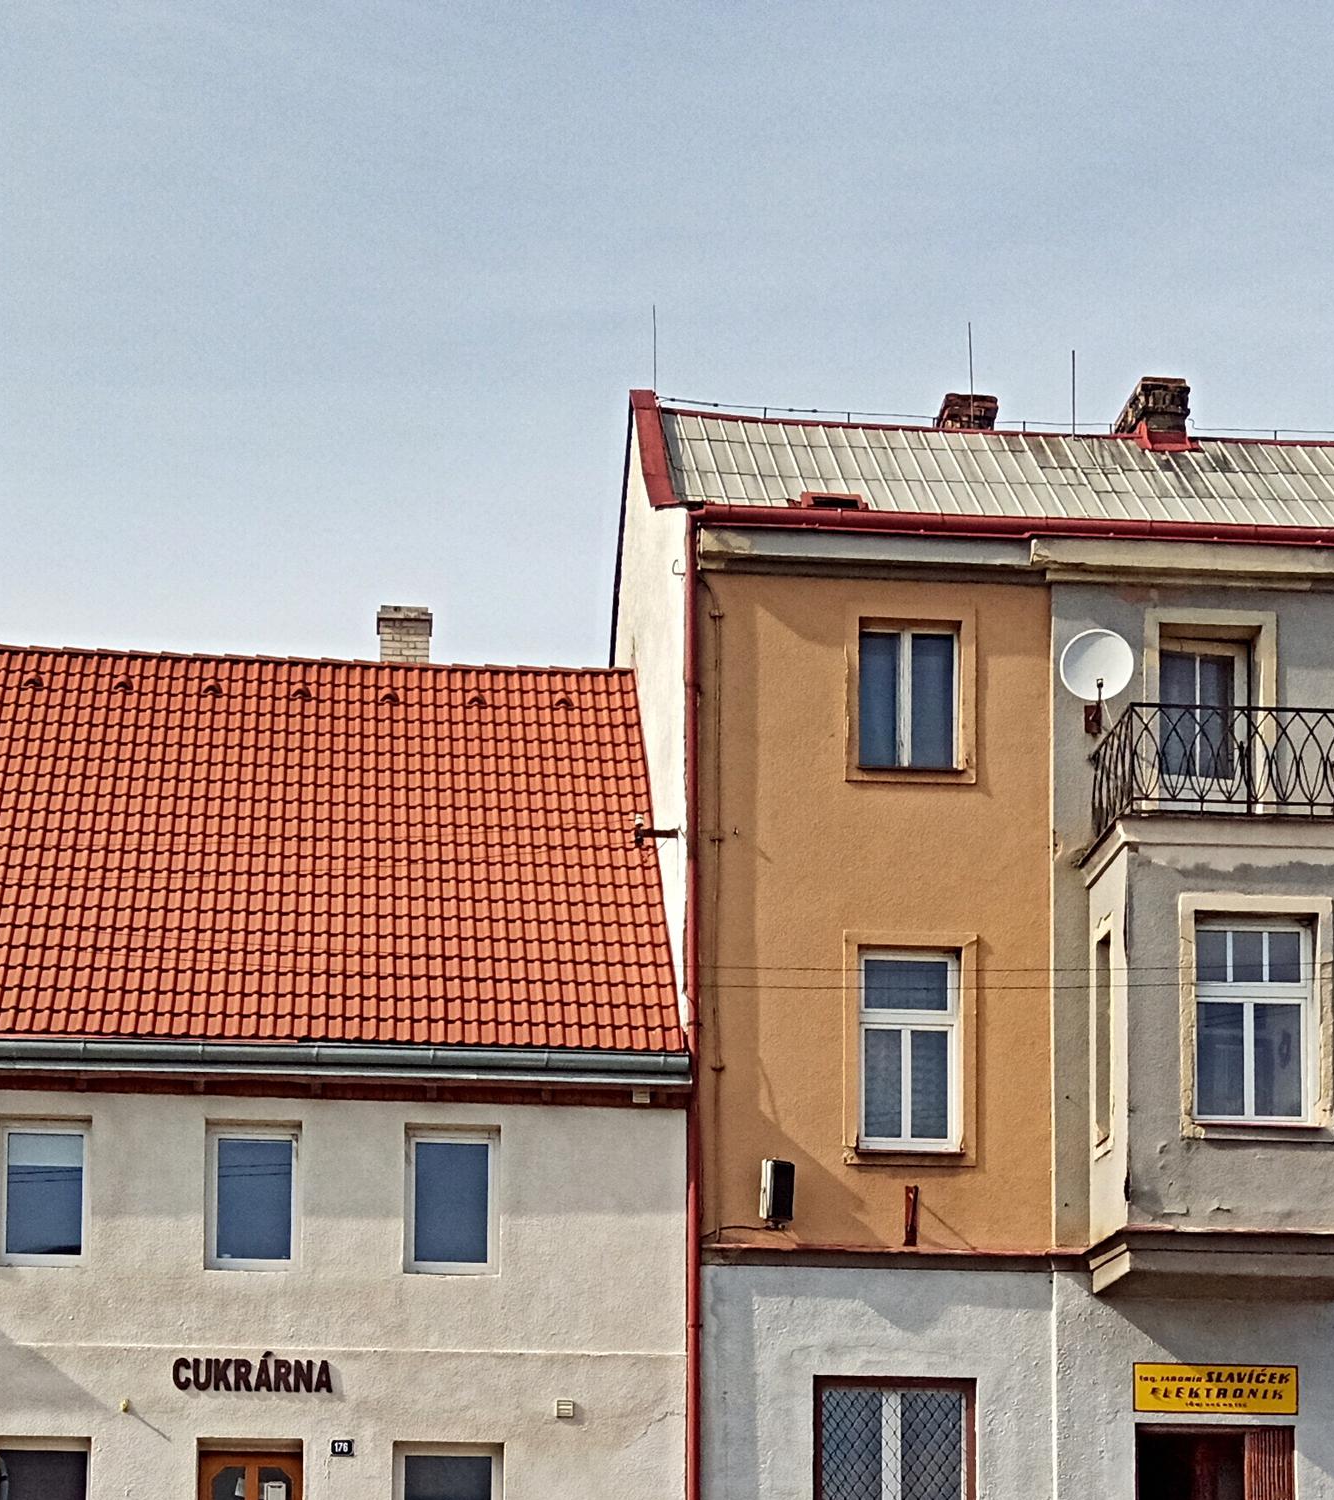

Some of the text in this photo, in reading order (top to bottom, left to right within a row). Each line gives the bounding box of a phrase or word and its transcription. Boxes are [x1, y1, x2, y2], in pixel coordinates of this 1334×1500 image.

[172, 1351, 334, 1393] CUKRÁRNA
[1205, 1368, 1291, 1384] SLAVÍČEK
[1150, 1387, 1284, 1400] ELEKTRONIK
[334, 1442, 349, 1452] 176
